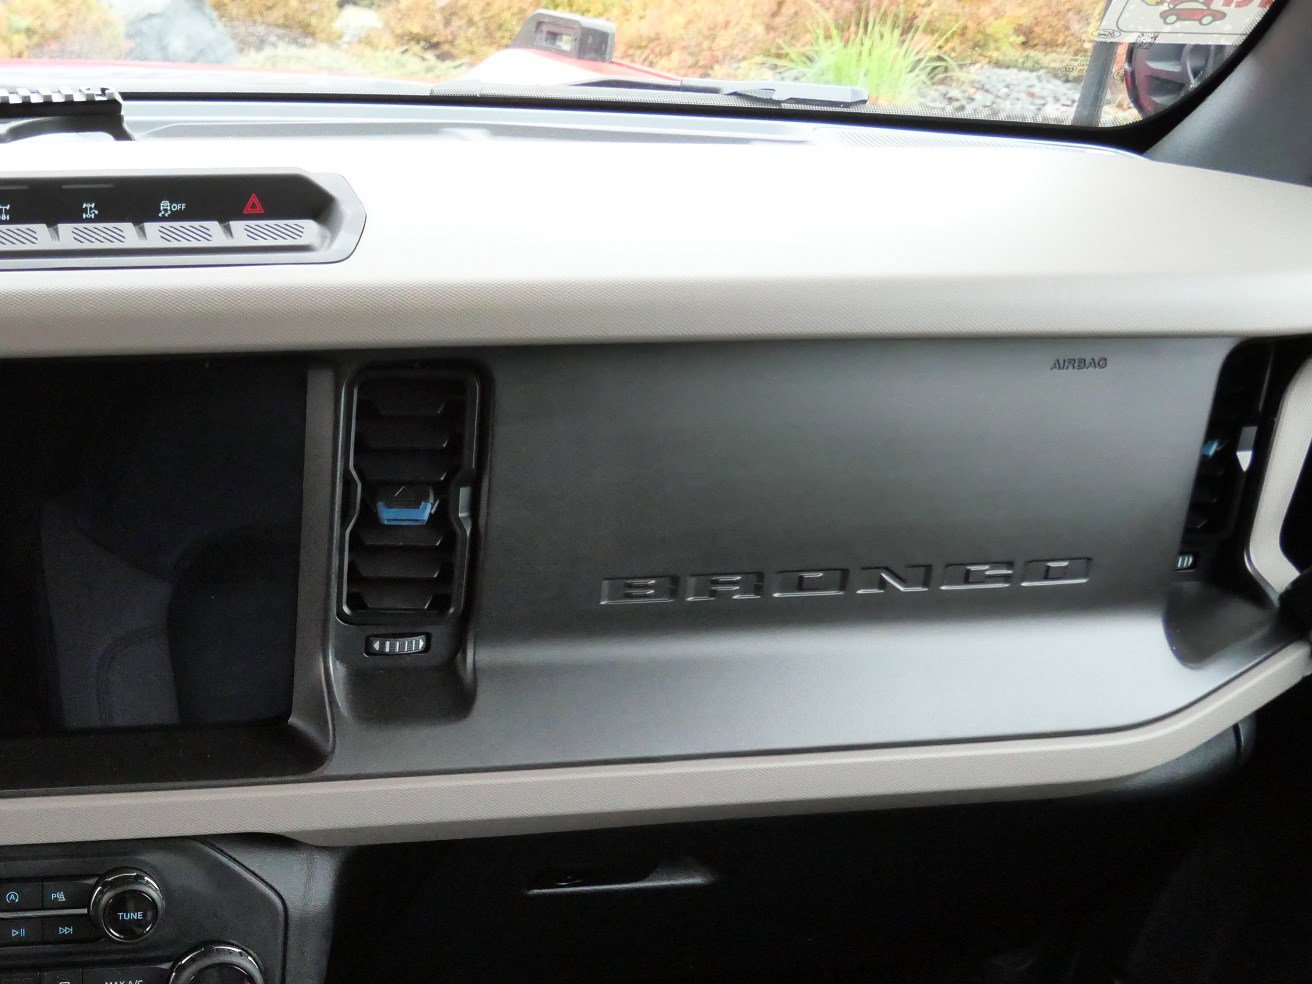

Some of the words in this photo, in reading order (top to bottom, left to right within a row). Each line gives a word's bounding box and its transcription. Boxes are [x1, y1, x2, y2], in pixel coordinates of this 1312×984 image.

[171, 203, 186, 211] OFF
[1049, 357, 1108, 371] AIRBAG
[600, 557, 1093, 605] BRONCO
[117, 910, 144, 921] TUNE
